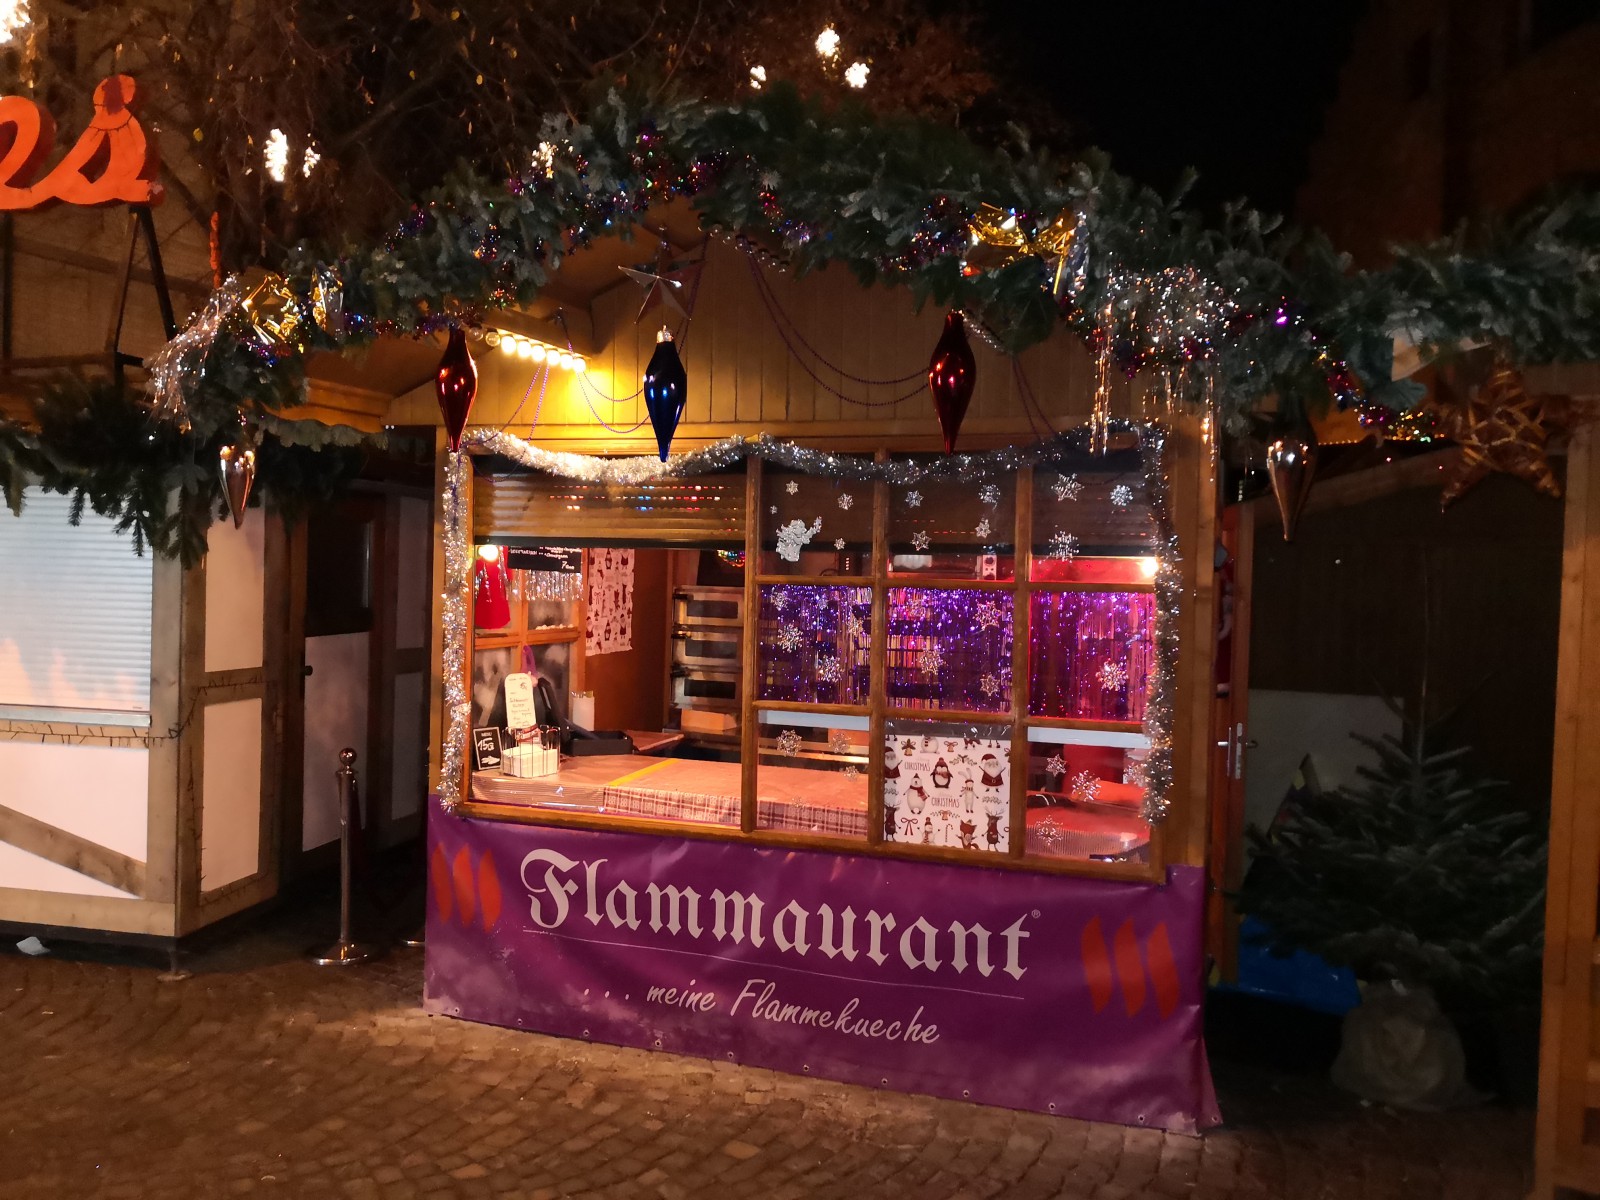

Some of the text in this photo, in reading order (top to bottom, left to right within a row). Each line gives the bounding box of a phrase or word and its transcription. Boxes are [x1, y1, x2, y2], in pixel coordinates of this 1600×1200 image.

[904, 761, 931, 771] CHRISTMAS
[931, 797, 960, 808] CHRISTMAS
[646, 979, 716, 1011] meine
[730, 978, 940, 1044] Flammekueche
